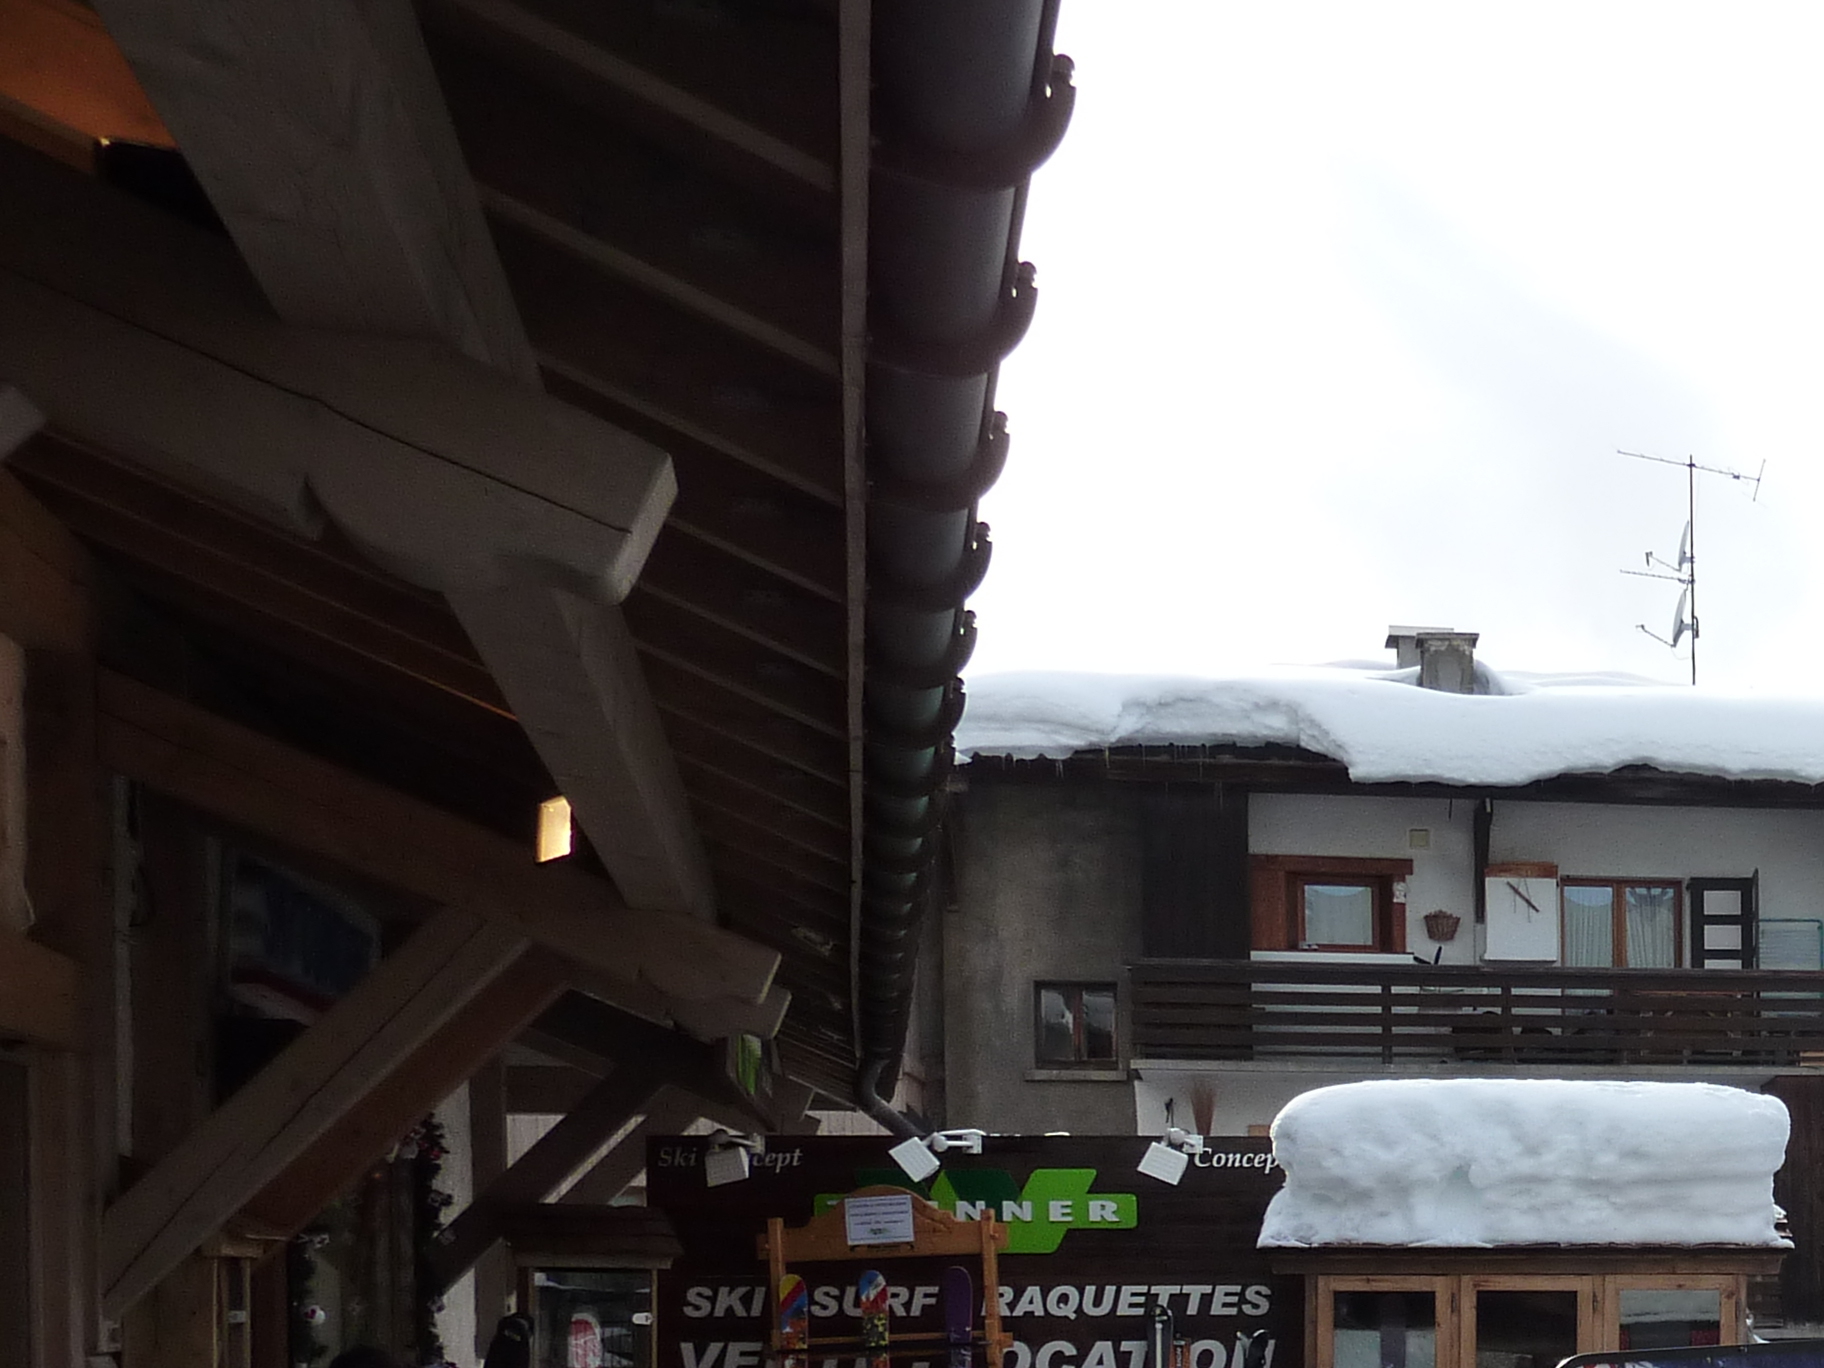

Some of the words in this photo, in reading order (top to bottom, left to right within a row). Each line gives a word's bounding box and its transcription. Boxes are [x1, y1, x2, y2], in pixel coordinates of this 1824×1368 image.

[658, 1147, 698, 1167] Ski
[1194, 1147, 1280, 1174] Concep
[682, 1286, 766, 1317] SKI
[981, 1285, 1272, 1320] RAQUETTES
